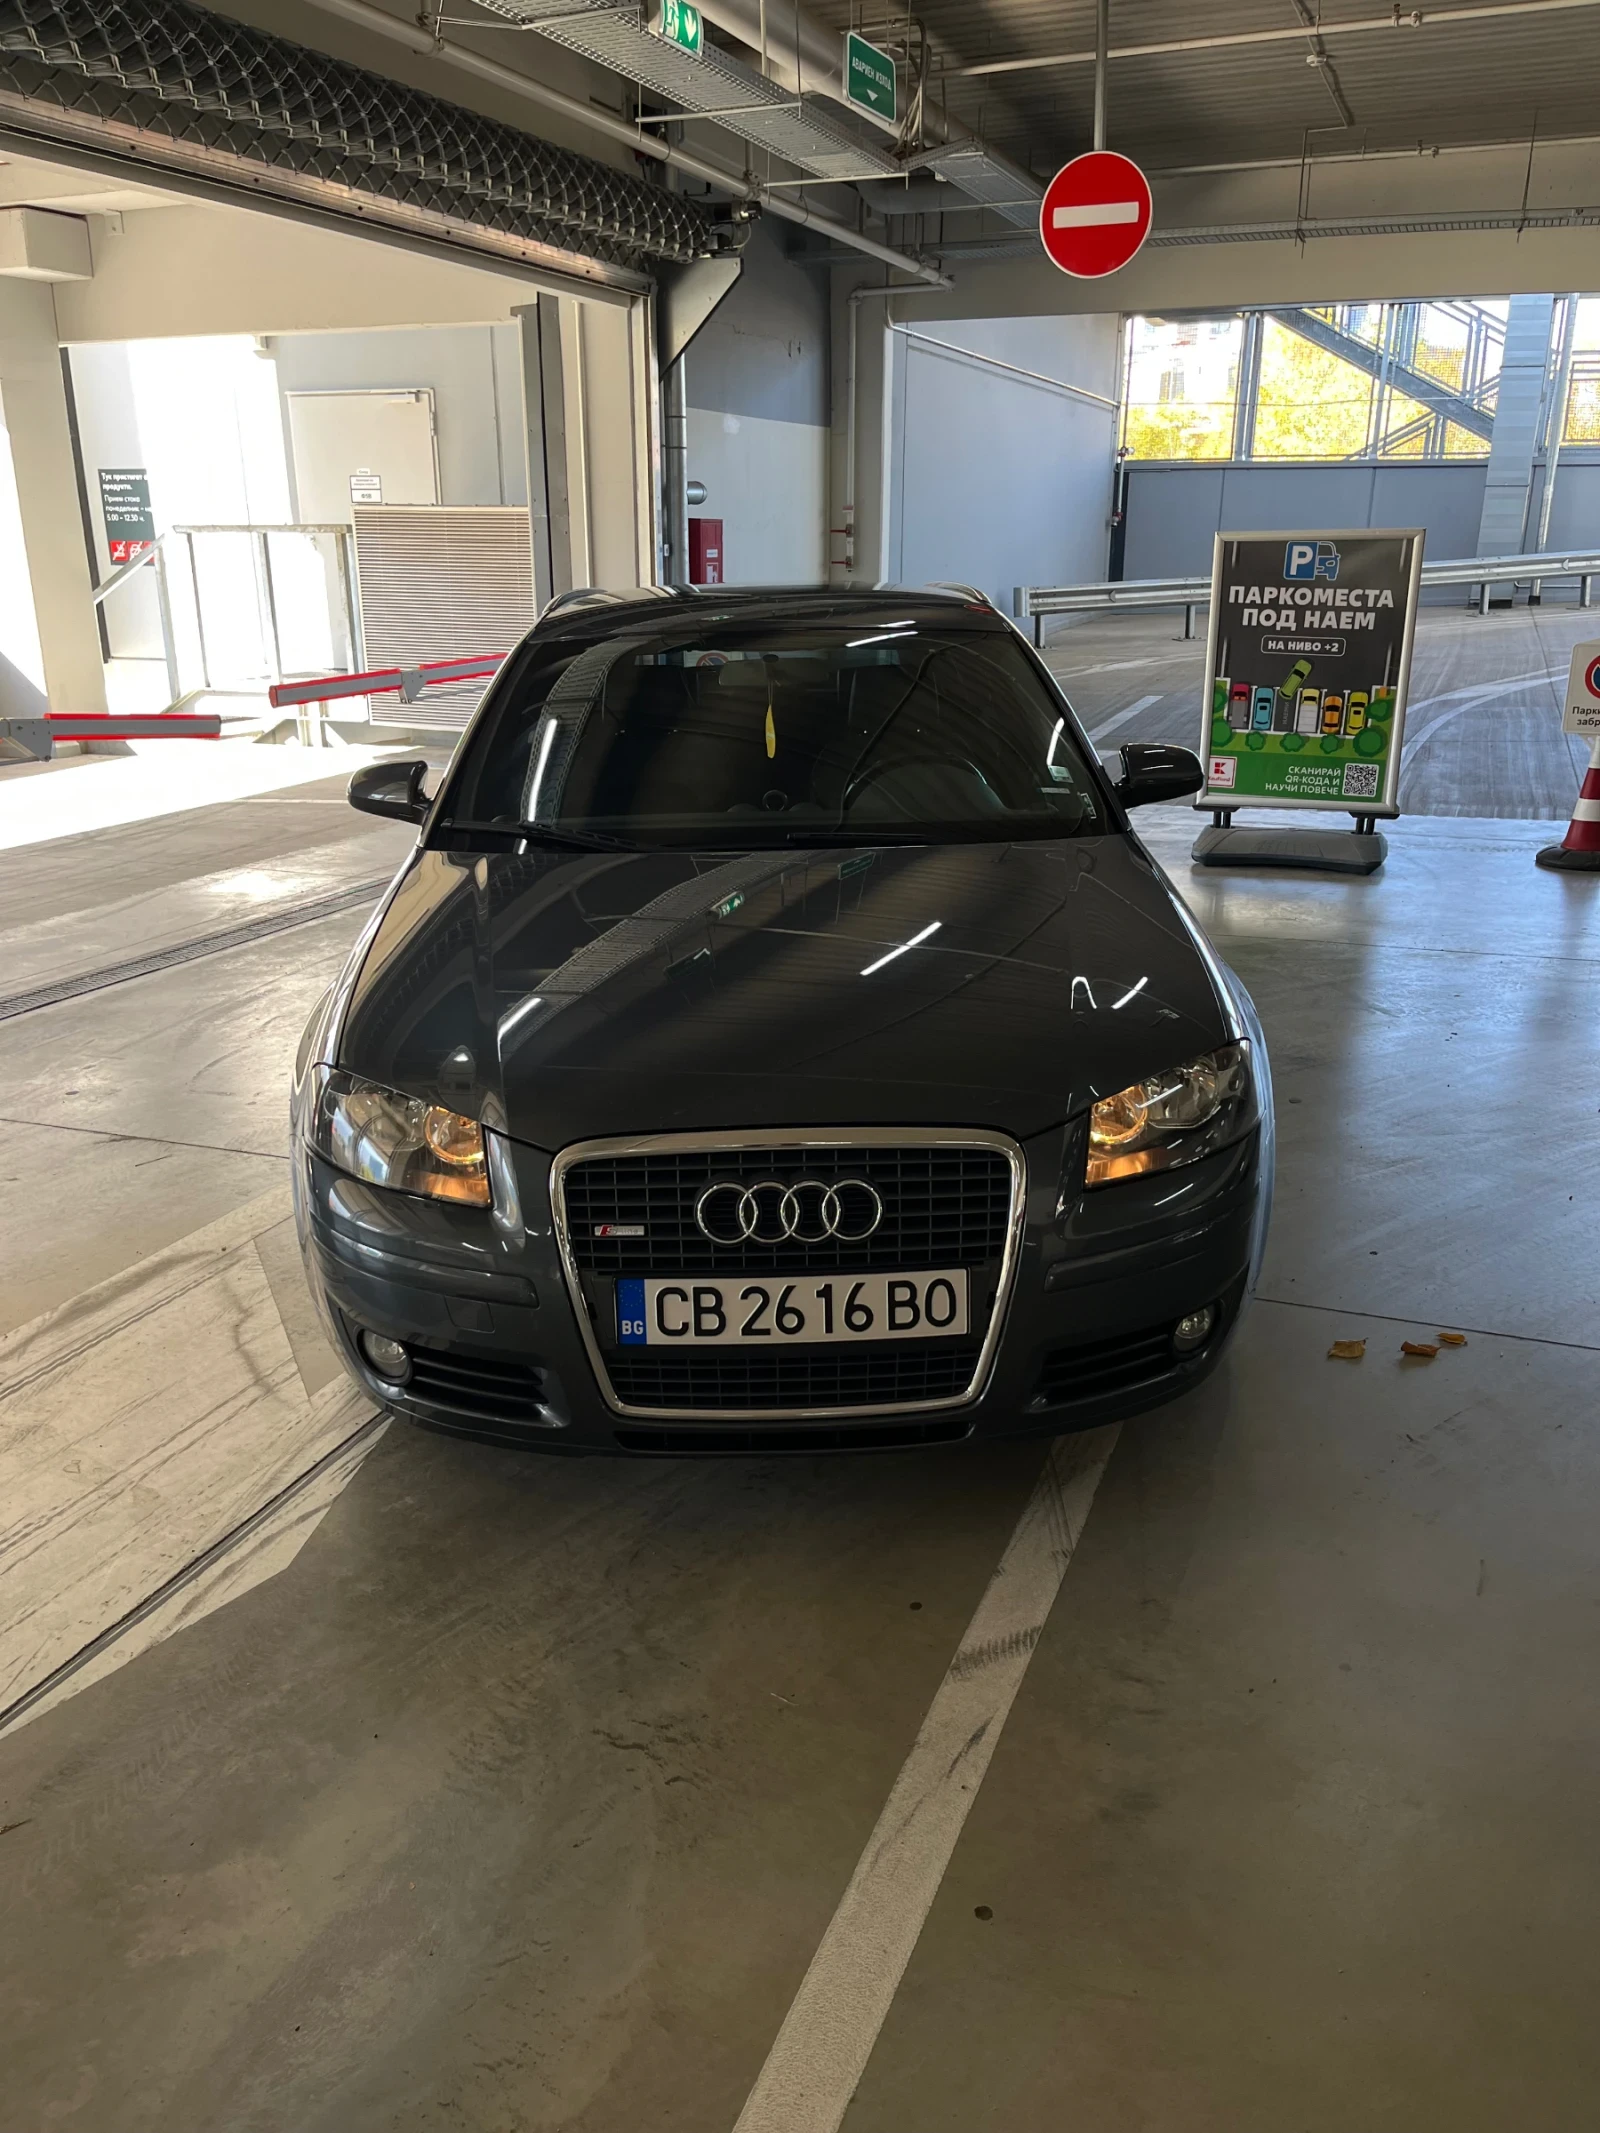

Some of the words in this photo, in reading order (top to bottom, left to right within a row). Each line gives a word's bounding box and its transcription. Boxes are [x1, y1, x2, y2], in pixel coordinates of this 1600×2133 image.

[852, 56, 875, 80] АВАРИЕН
[875, 71, 892, 92] ИЗХОД
[101, 472, 112, 481] Тук
[1290, 545, 1314, 575] P
[1228, 585, 1395, 608] ПАРКОМЕСТА
[1242, 608, 1297, 631] ПОД
[1303, 610, 1376, 630] НАЕМ
[1267, 640, 1285, 650] НА
[1288, 641, 1322, 651] НИВО
[1324, 642, 1339, 652] +2
[1288, 765, 1341, 776] СКАНИРАЙ
[1285, 776, 1331, 786] QR-КОДА
[1332, 778, 1340, 786] И
[1265, 783, 1299, 793] НАУЧИ
[1300, 785, 1339, 795] ПОВЕЧЕ
[655, 1286, 727, 1337] CB
[739, 1282, 874, 1336] 2616
[887, 1277, 957, 1331] BO
[621, 1320, 644, 1335] BG
